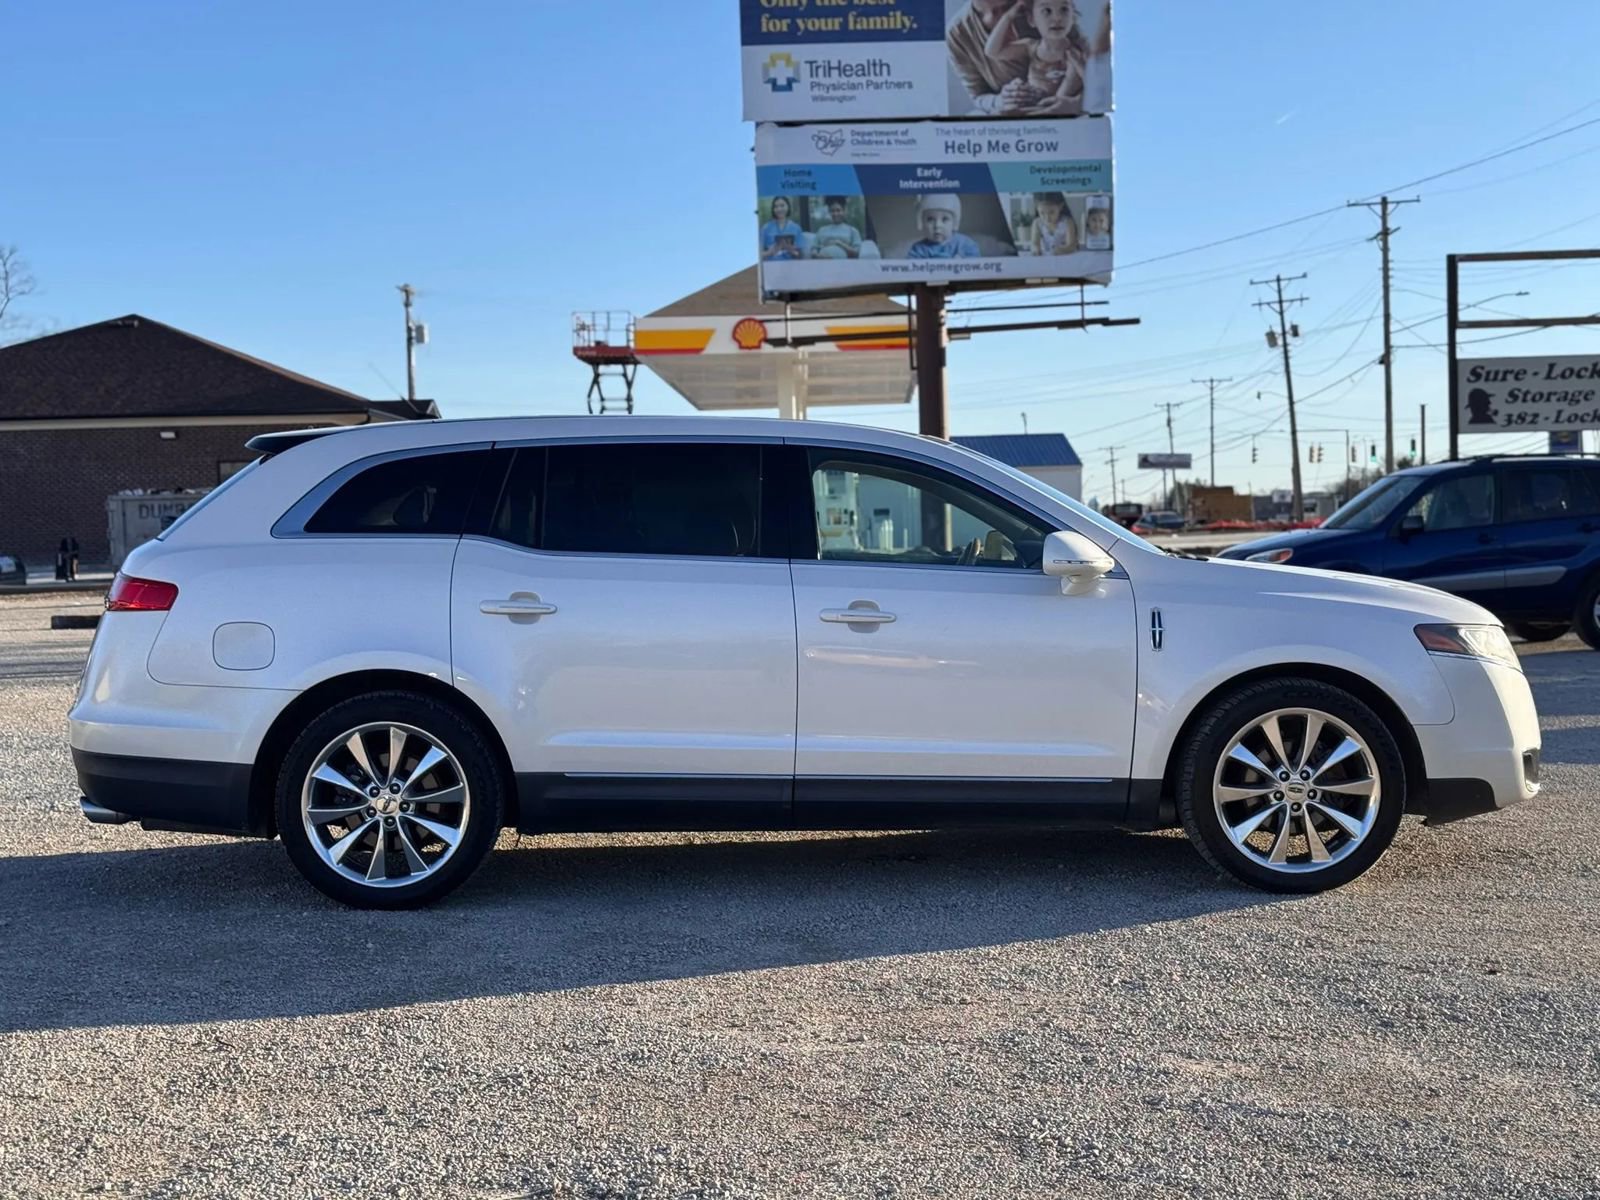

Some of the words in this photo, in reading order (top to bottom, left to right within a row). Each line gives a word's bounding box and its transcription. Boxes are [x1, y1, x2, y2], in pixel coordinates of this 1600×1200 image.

[761, 13, 791, 32] for
[795, 17, 843, 36] your
[848, 10, 918, 34] family.
[804, 59, 891, 78] TriHealth
[810, 80, 864, 94] Physician
[865, 79, 913, 90] Partners
[850, 129, 898, 139] Department
[900, 128, 909, 137] of
[936, 127, 951, 136] The
[953, 127, 975, 136] heart
[977, 126, 986, 136] of
[988, 126, 1021, 137] thriving
[850, 138, 884, 146] Children
[944, 139, 982, 157] Help
[987, 139, 1011, 153] Me
[1015, 139, 1059, 153] Grow
[917, 167, 942, 179] Early
[1029, 163, 1102, 175] Developmental
[899, 178, 960, 189] Intervention
[1040, 175, 1092, 186] Screenings
[881, 262, 1003, 275] www.helpmegrow.org
[1467, 365, 1527, 383] Sure
[1505, 387, 1595, 406] Storage
